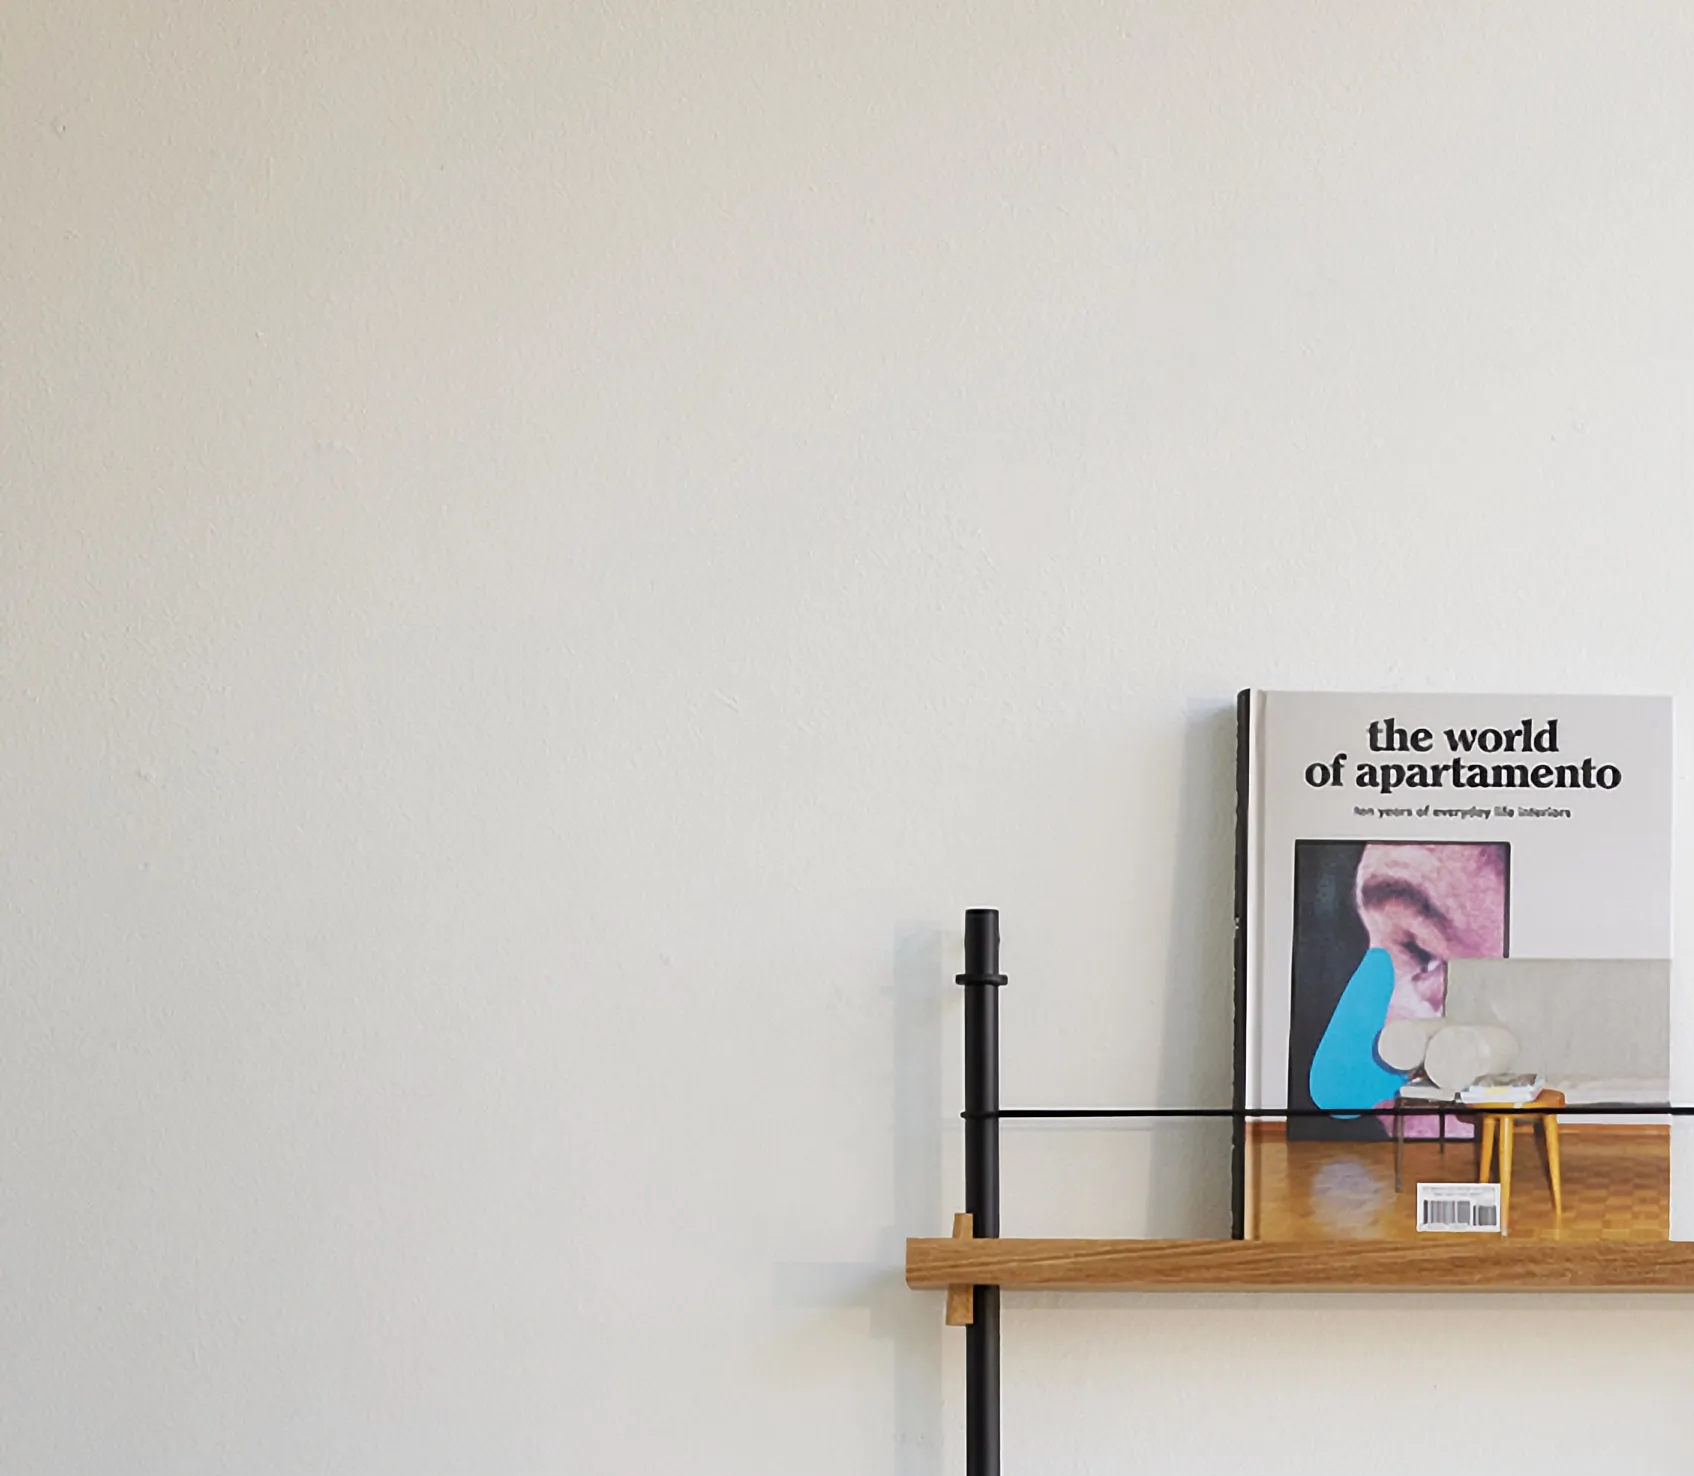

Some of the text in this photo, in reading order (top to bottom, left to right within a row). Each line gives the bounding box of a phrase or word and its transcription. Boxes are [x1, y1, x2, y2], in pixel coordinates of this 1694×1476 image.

[1366, 718, 1560, 752] the world
[1305, 753, 1622, 794] of apartamento
[1377, 808, 1413, 819] years
[1416, 804, 1431, 818] of
[1433, 806, 1491, 820] everyday
